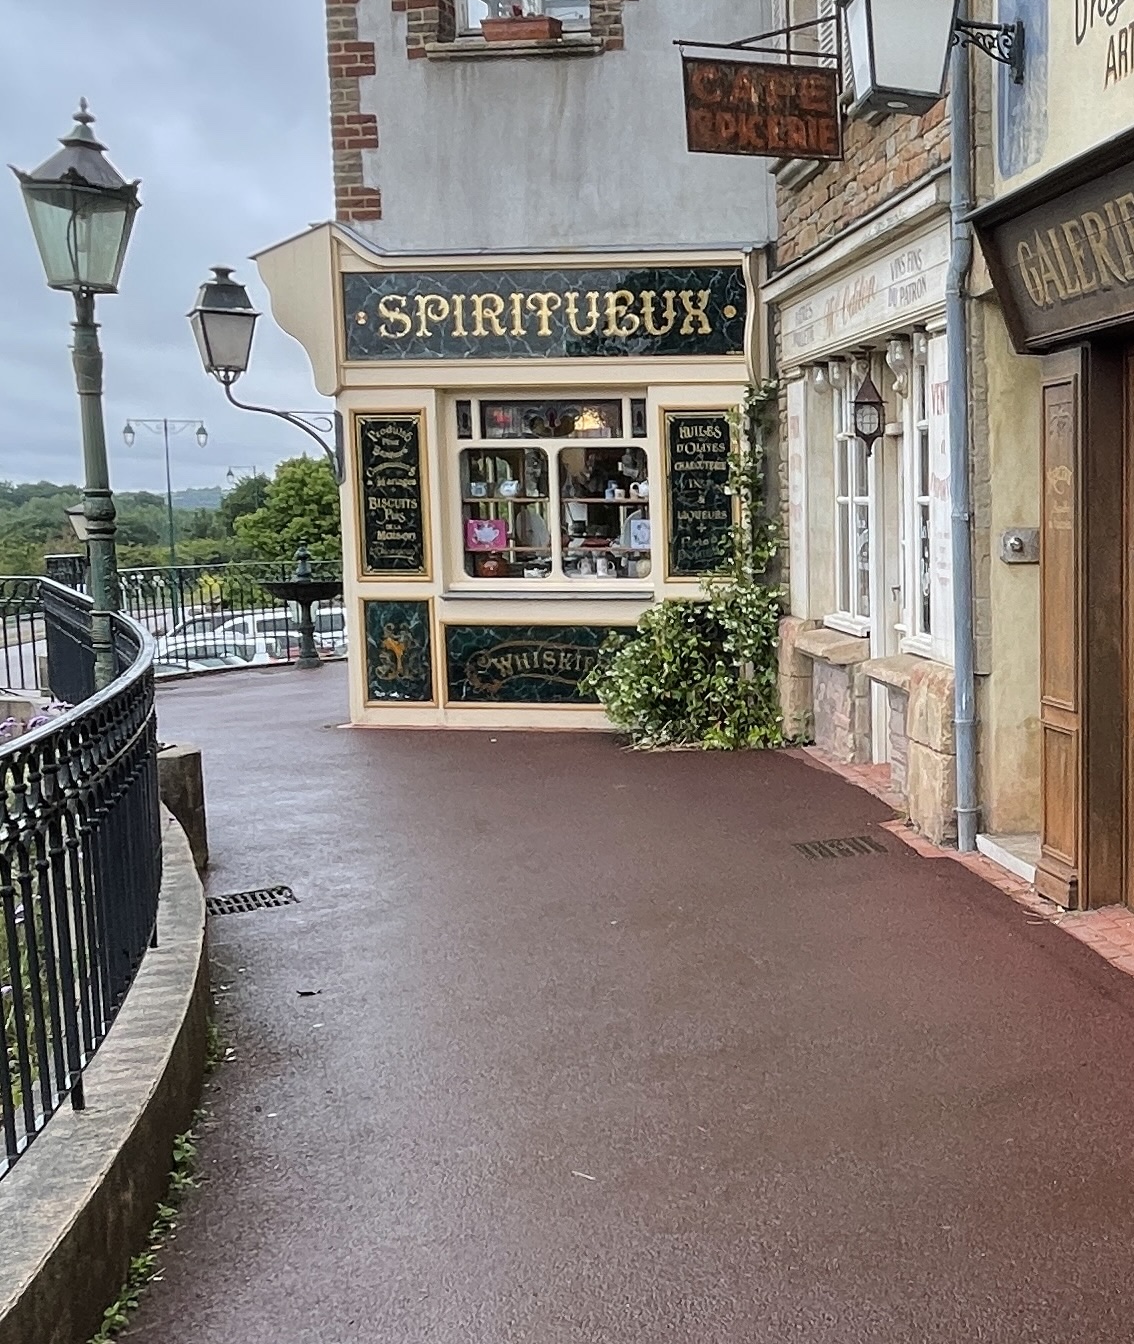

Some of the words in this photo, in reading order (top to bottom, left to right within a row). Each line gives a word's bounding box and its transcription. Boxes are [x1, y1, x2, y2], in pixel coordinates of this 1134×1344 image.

[899, 275, 928, 307] PATRON
[377, 289, 713, 339] SPIRITUEUX
[678, 425, 722, 439] HUILES
